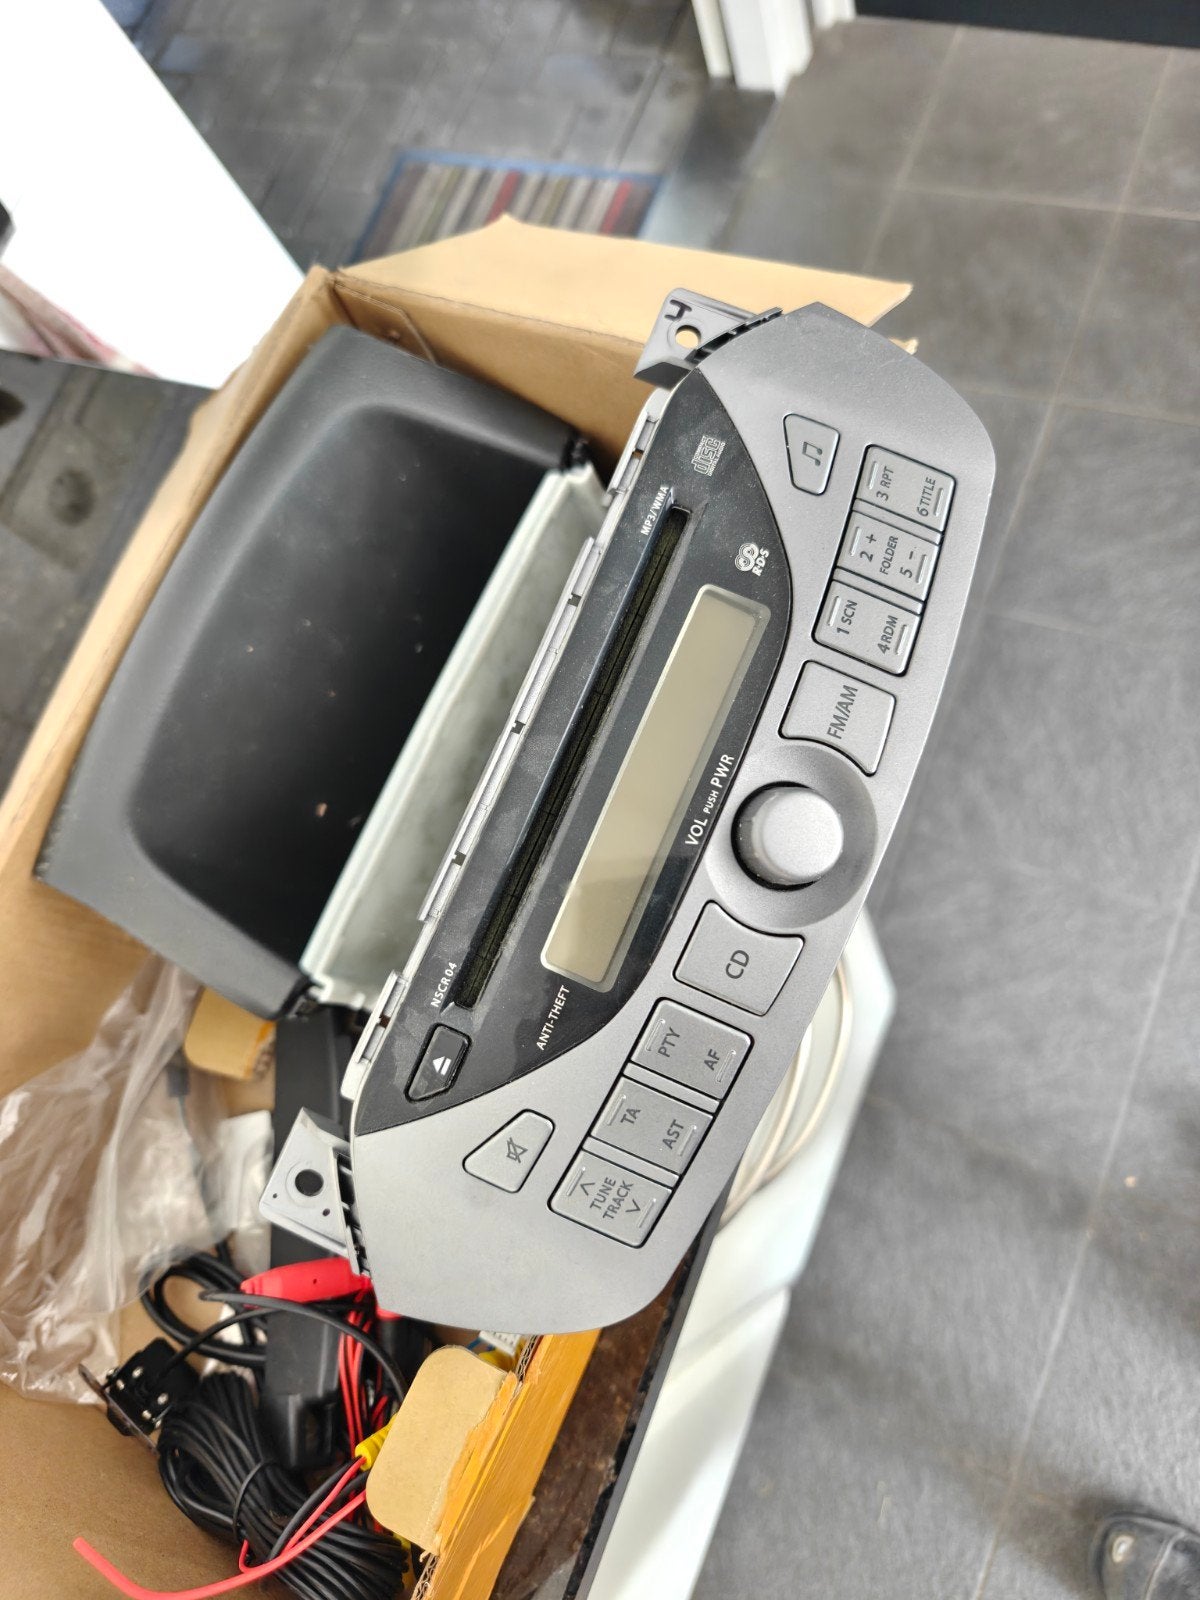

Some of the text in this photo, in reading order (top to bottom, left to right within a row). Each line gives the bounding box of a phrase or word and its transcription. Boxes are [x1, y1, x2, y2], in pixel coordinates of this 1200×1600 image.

[876, 466, 895, 502] 3 RPT
[641, 485, 669, 536] MP3/WMA
[860, 550, 873, 563] 2
[880, 535, 899, 575] FOLDER
[900, 566, 913, 579] 5
[836, 600, 858, 636] 1 SCN
[827, 685, 858, 739] FM/AM
[685, 754, 735, 846] VOL PUSH PWR
[725, 950, 750, 979] CD
[536, 985, 570, 1050] ANTI-THEFT
[657, 1027, 681, 1058] PTY
[703, 1048, 721, 1071] AF
[621, 1106, 641, 1125] TA
[662, 1119, 685, 1150] AST
[590, 1176, 617, 1211] TUNE
[603, 1180, 634, 1220] TRACK
